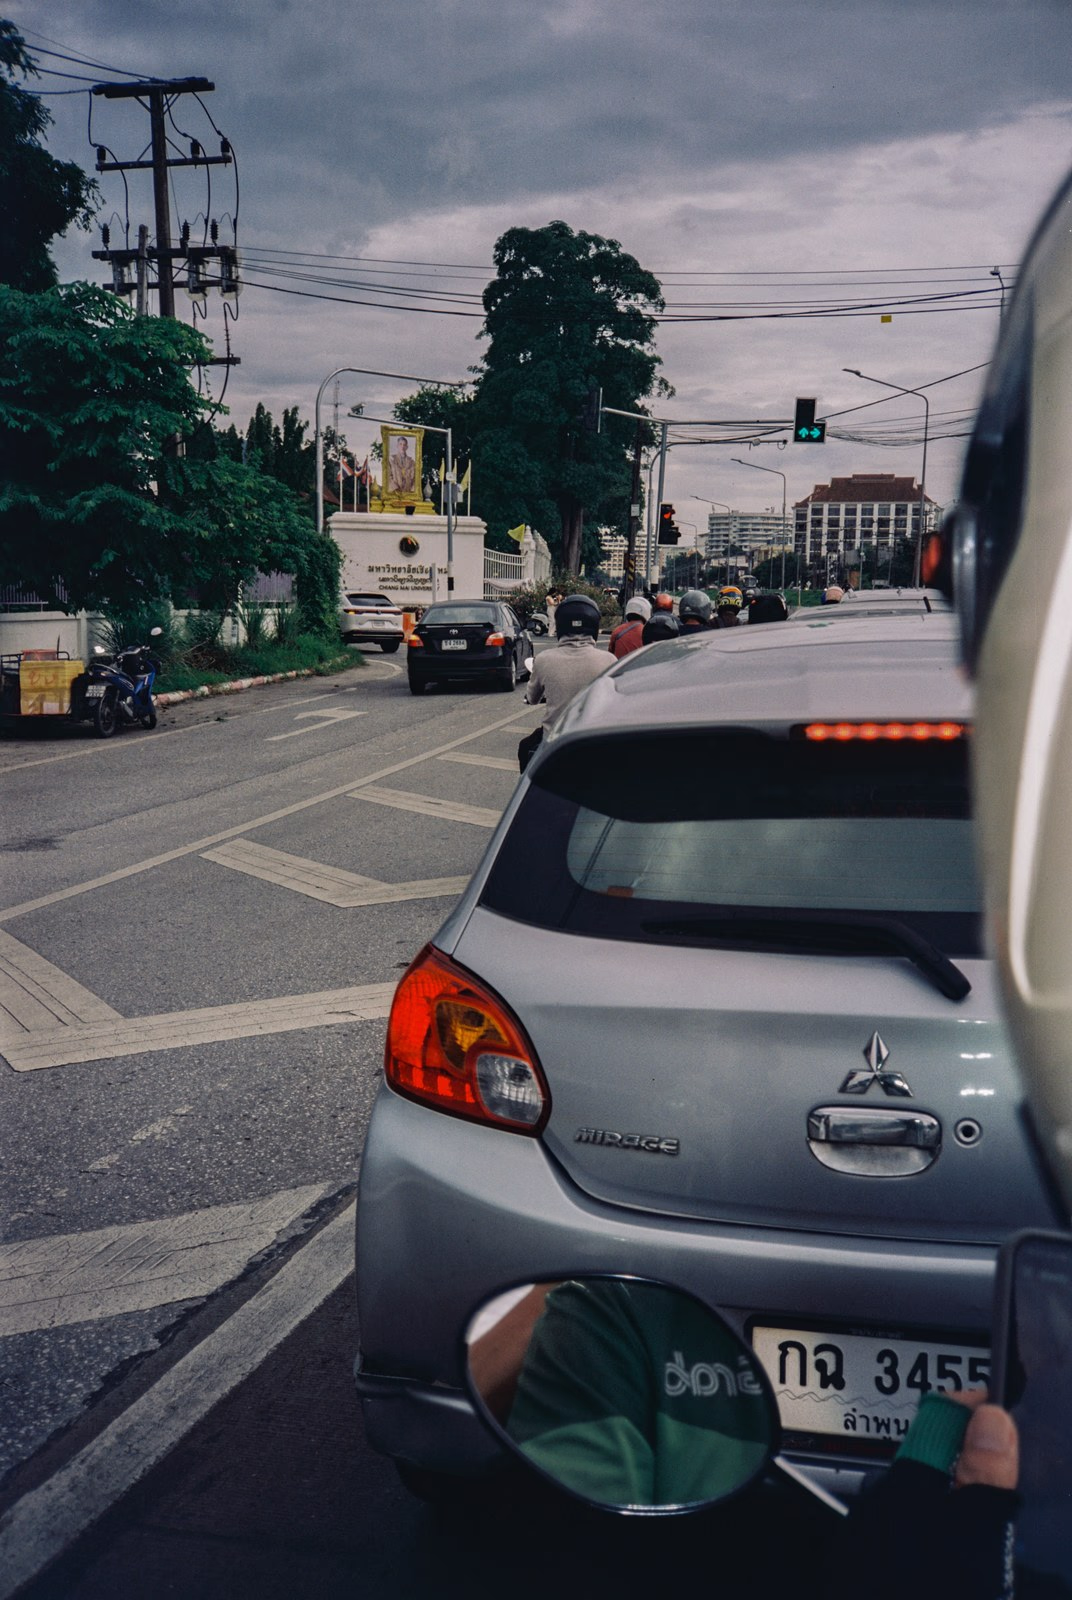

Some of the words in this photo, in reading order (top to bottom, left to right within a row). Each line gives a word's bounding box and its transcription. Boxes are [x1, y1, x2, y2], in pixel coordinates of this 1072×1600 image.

[575, 1127, 680, 1156] MIRAGE
[777, 1340, 847, 1391] กฉ
[843, 1407, 912, 1441] ลำพูน
